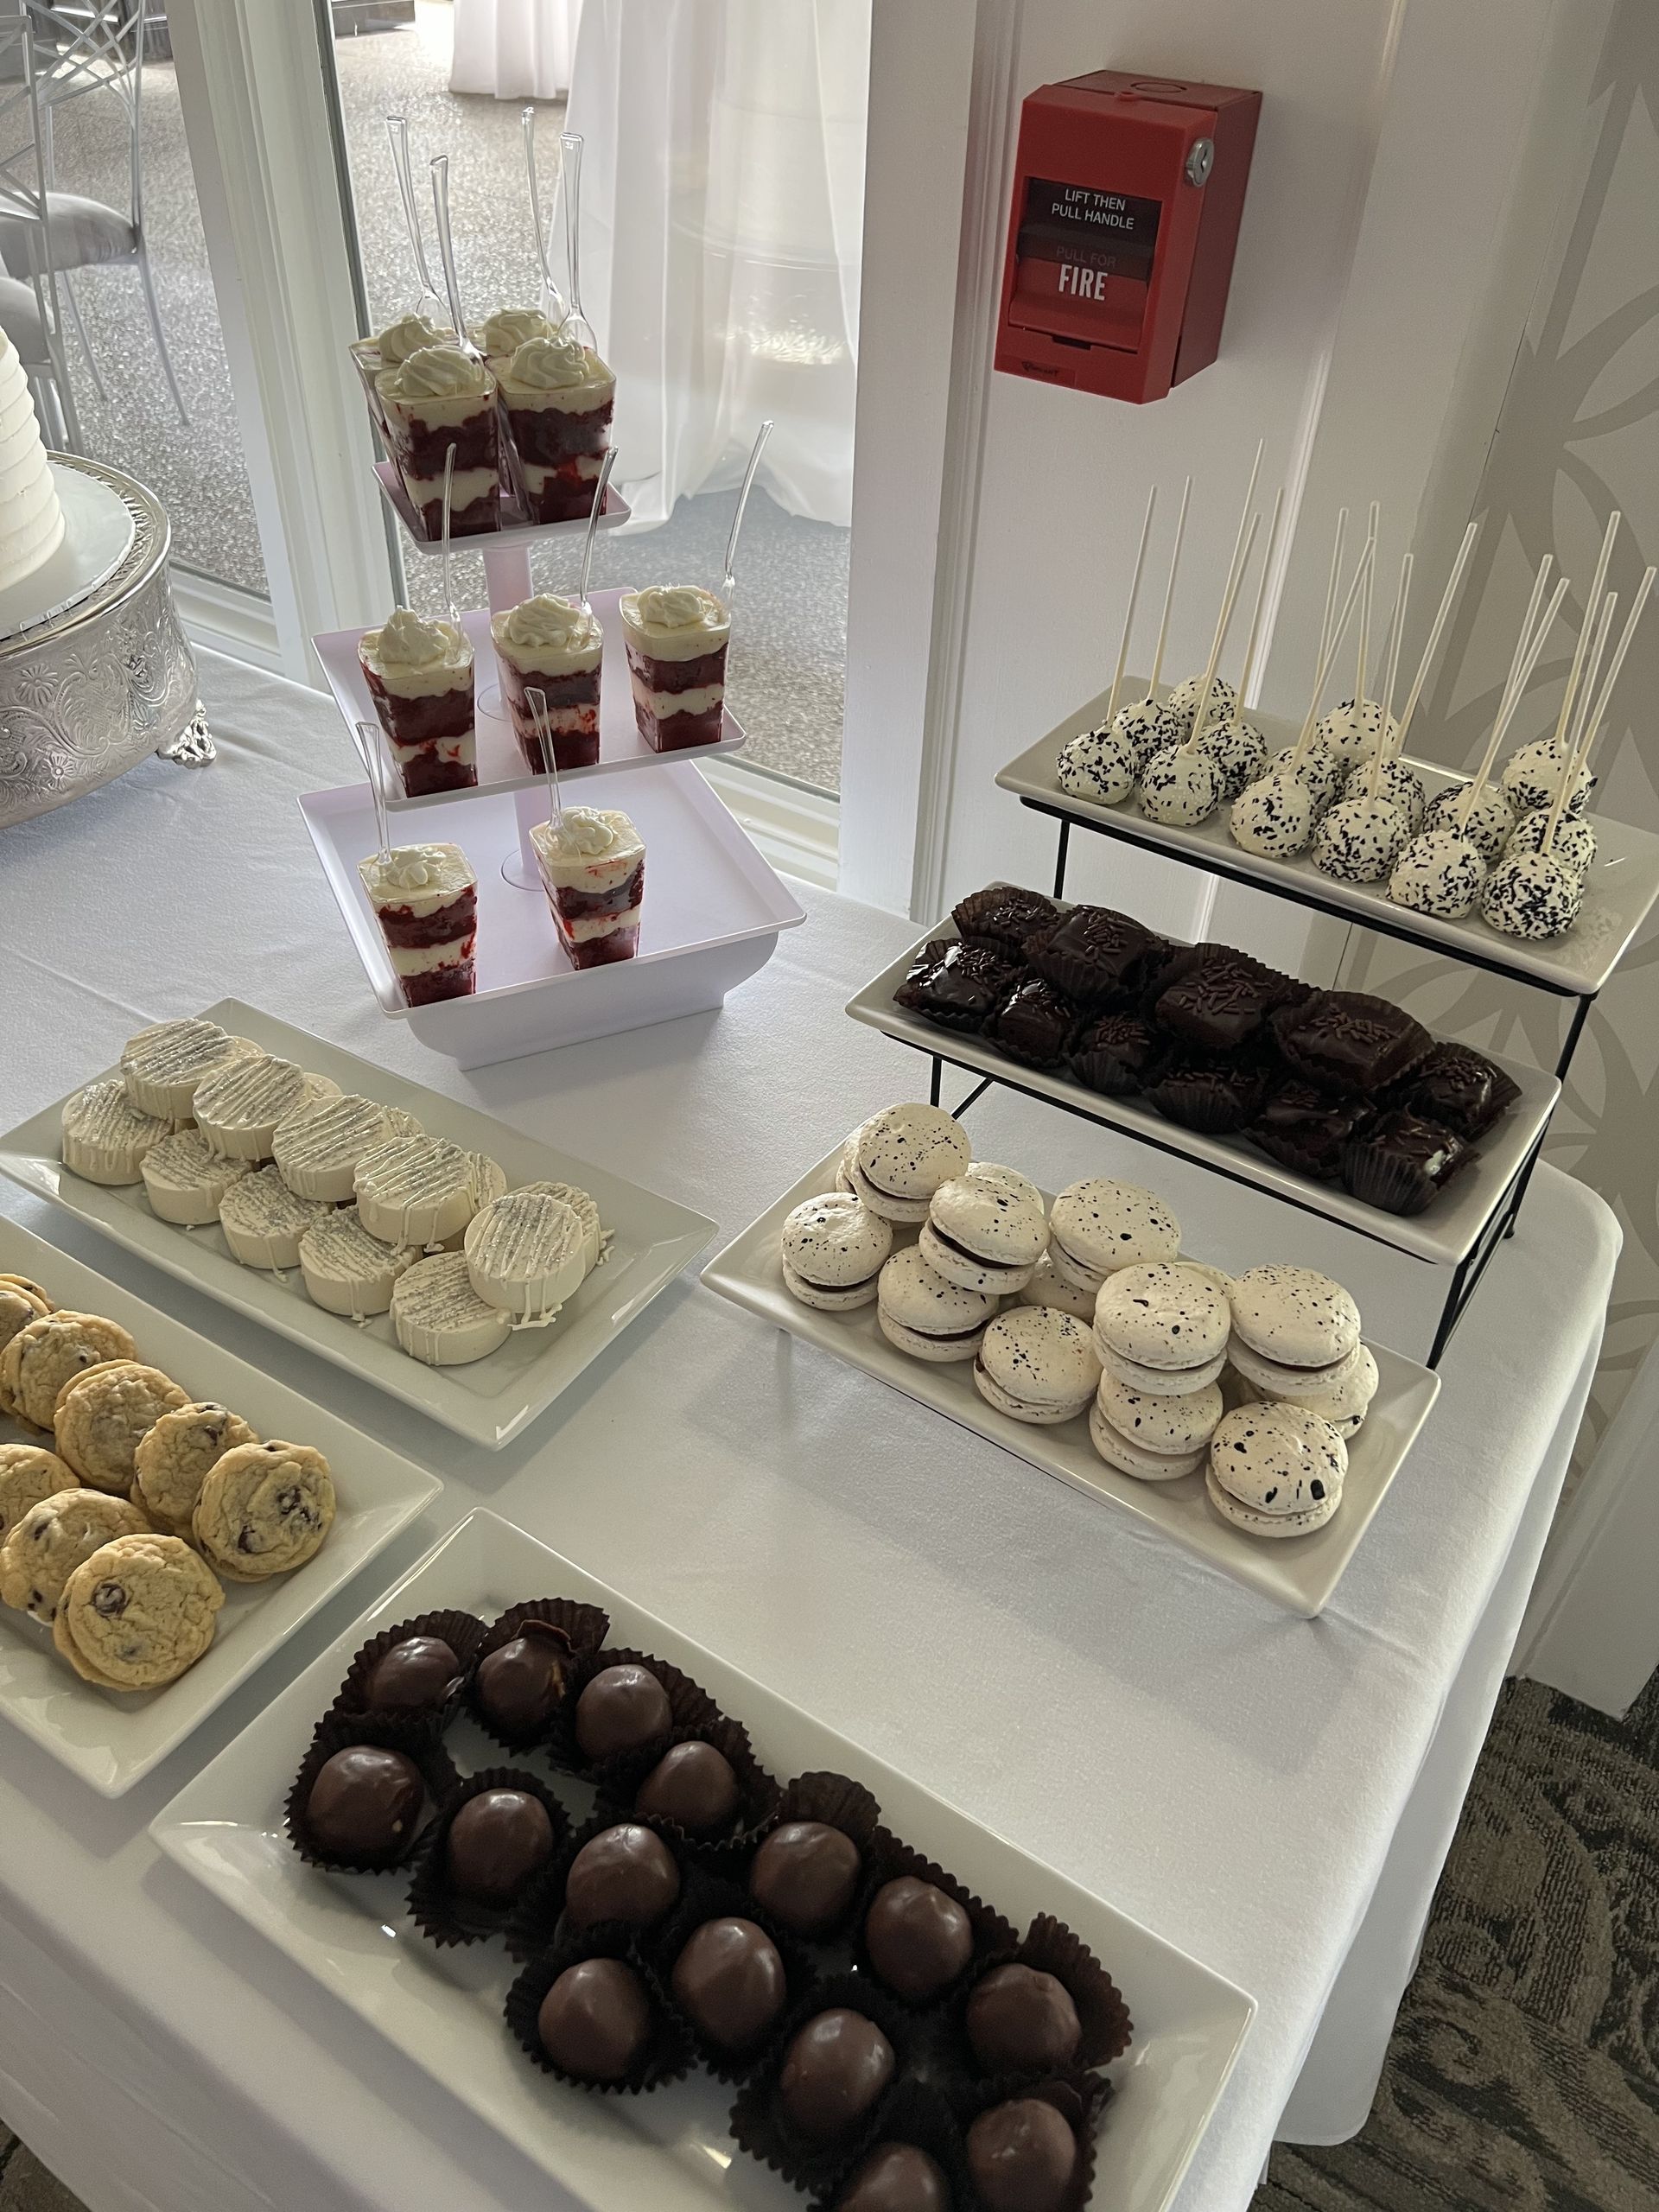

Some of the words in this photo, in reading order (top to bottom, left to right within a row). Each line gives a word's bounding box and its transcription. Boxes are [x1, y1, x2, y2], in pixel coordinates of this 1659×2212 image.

[1065, 188, 1090, 205] LIFT
[1093, 194, 1126, 212] THEN
[1052, 202, 1082, 220] PULL
[1084, 209, 1135, 230] HANDLE
[1057, 245, 1086, 264] PULL
[1090, 253, 1116, 269] FOR
[1058, 264, 1108, 301] FIRE
